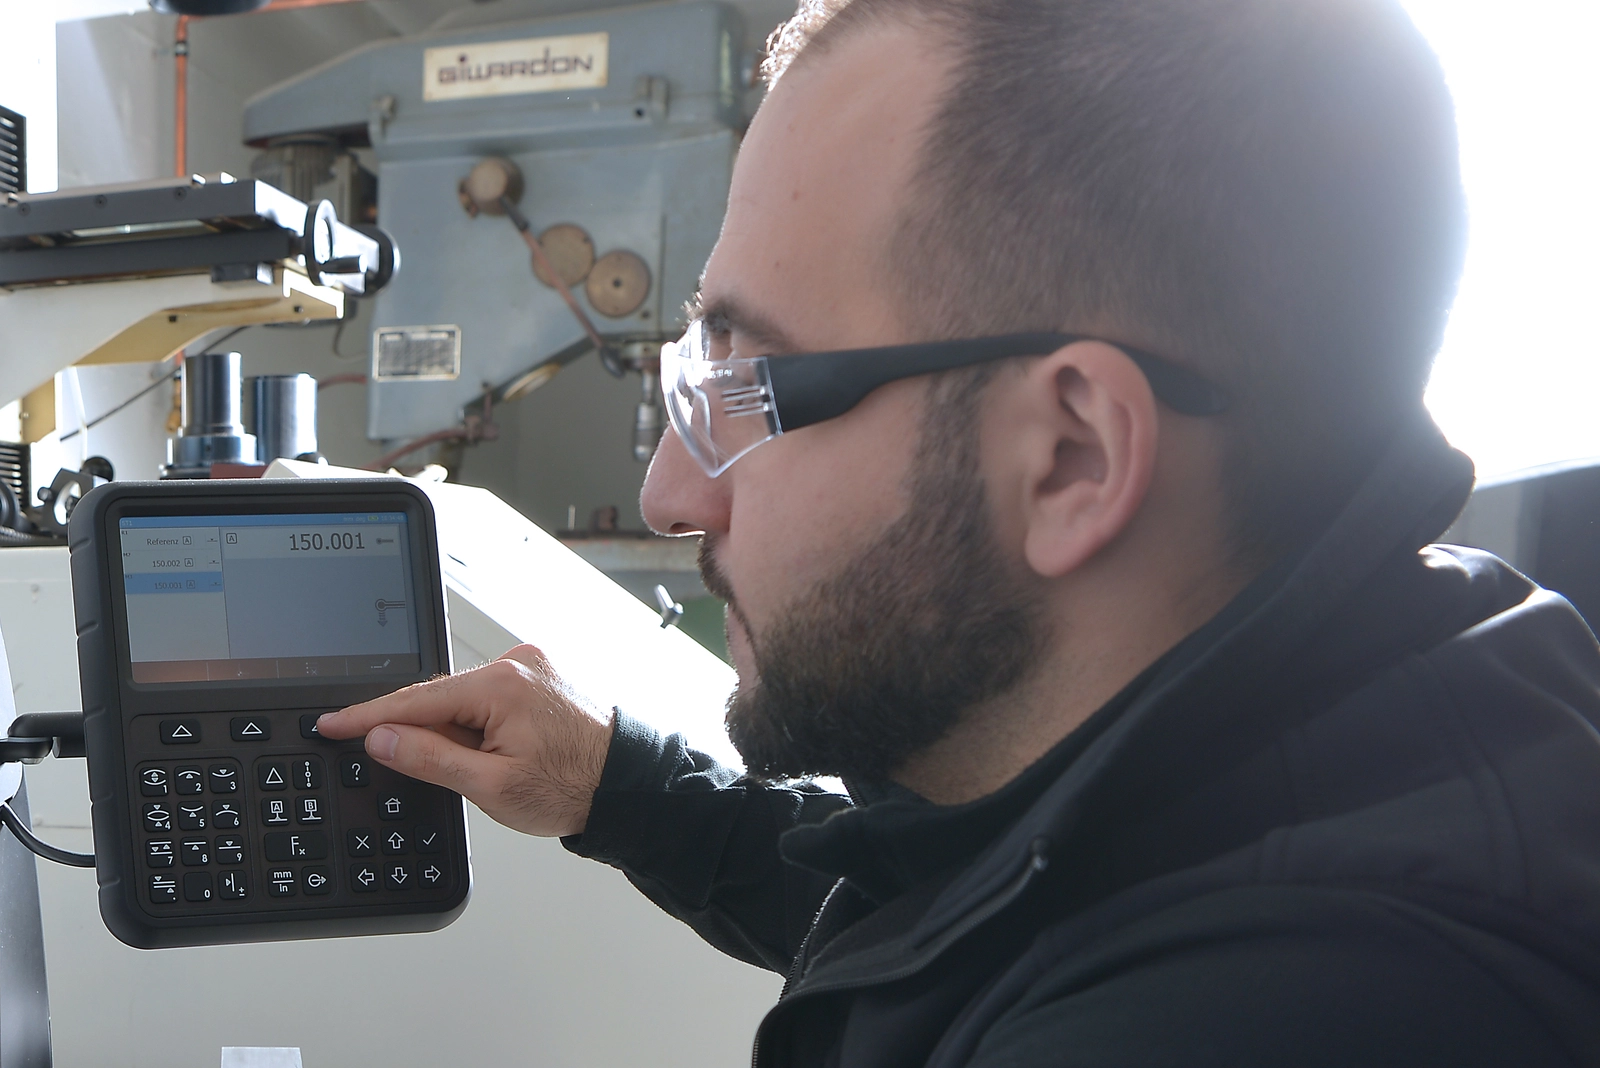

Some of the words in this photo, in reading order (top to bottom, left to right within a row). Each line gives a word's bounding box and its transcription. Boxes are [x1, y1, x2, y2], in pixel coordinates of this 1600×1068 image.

[146, 538, 179, 546] Referenz
[289, 532, 366, 551] 150.001
[152, 560, 181, 568] 150.002
[154, 582, 182, 590] 150.001
[163, 785, 168, 793] 1
[195, 783, 202, 791] 2
[230, 781, 236, 790] 3
[164, 821, 171, 830] 4
[199, 819, 205, 827] 5
[233, 817, 240, 826] 6
[168, 856, 174, 864] 7
[201, 854, 208, 863] 8
[236, 853, 242, 861] 9
[273, 870, 292, 879] mm
[204, 889, 211, 898] 0
